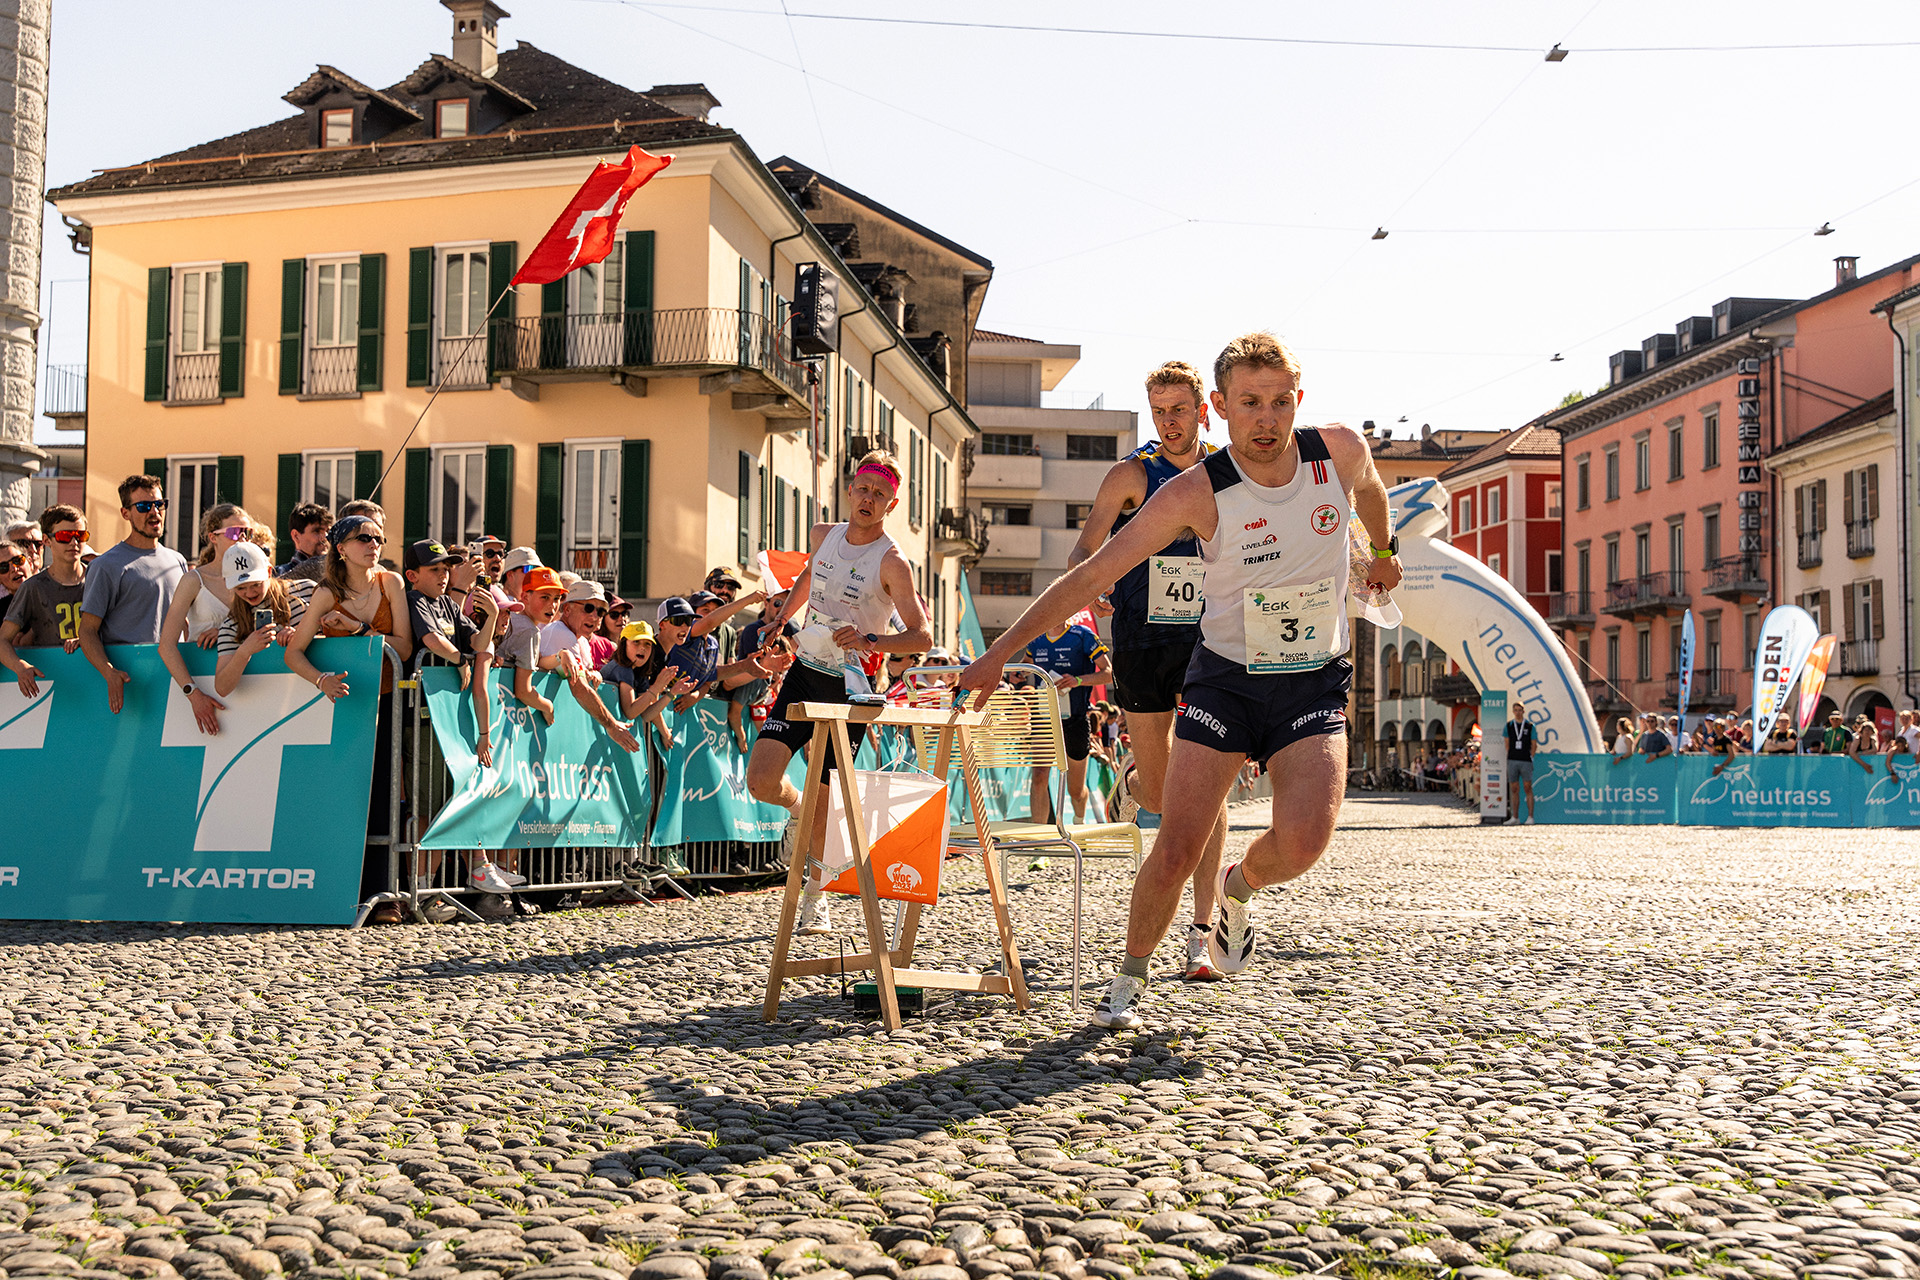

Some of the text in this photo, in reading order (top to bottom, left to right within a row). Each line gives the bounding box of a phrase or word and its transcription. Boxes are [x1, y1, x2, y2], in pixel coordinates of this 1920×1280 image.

[1746, 357, 1760, 482] CINEMA
[1747, 491, 1760, 551] REX
[1241, 538, 1274, 550] LIVELOX
[1243, 550, 1281, 565] TRIMTEX
[1161, 566, 1181, 575] EGK
[1403, 564, 1457, 572] Versicherungen
[851, 573, 866, 582] EGK
[1166, 582, 1194, 602] 40
[1404, 583, 1434, 591] Finanzen
[1262, 600, 1290, 611] EGK
[1280, 618, 1316, 642] 3 2
[1759, 636, 1783, 732] GOLDEN
[1483, 699, 1505, 707] START
[1186, 705, 1227, 739] NORGE
[516, 754, 612, 802] neutrass
[1564, 784, 1659, 802] neutrass
[1731, 787, 1832, 806] neutrass
[518, 820, 617, 836] Versicherungen Vorsorge Finanzen
[142, 867, 316, 889] T-KARTOR
[893, 873, 911, 883] WOC
